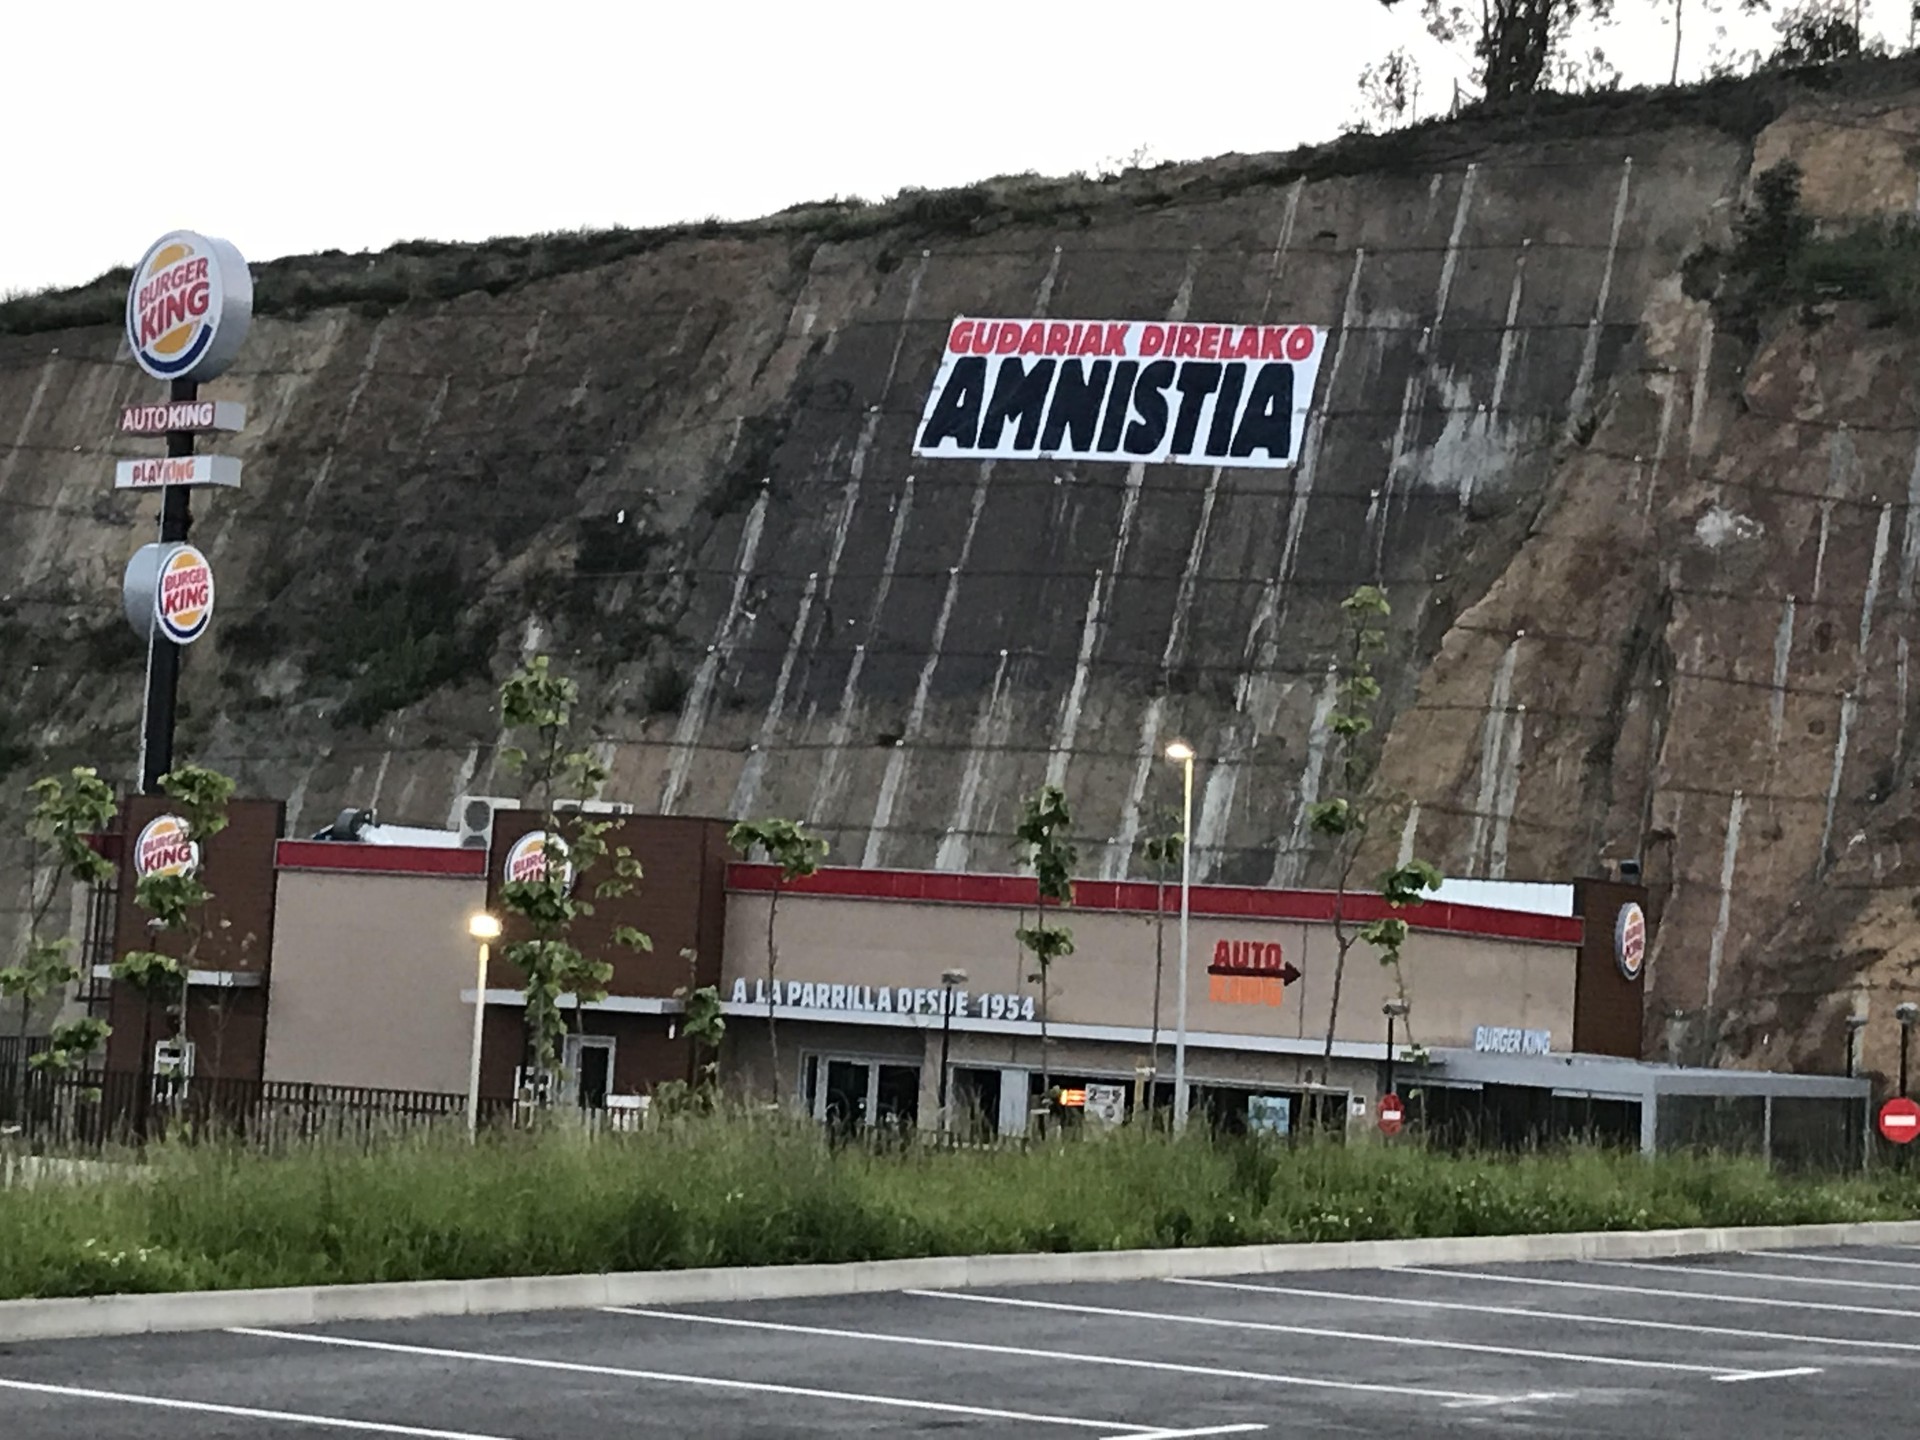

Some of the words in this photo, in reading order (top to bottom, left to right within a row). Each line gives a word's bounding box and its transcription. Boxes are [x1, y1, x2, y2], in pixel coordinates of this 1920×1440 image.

[139, 257, 208, 315] BURGER
[140, 281, 210, 348] KING
[948, 320, 1131, 357] GUDARIAK
[1140, 323, 1315, 361] DIRELAKO
[919, 356, 1294, 458] AMNISTIA
[164, 567, 208, 592] BURGER
[164, 584, 208, 616] KING
[144, 844, 192, 874] KING
[1214, 939, 1283, 969] AUTO
[732, 977, 747, 1003] A
[756, 978, 782, 1006] LA
[787, 981, 891, 1013] PARRILLA
[977, 993, 1035, 1021] 1954
[1475, 1025, 1521, 1053] BURGER
